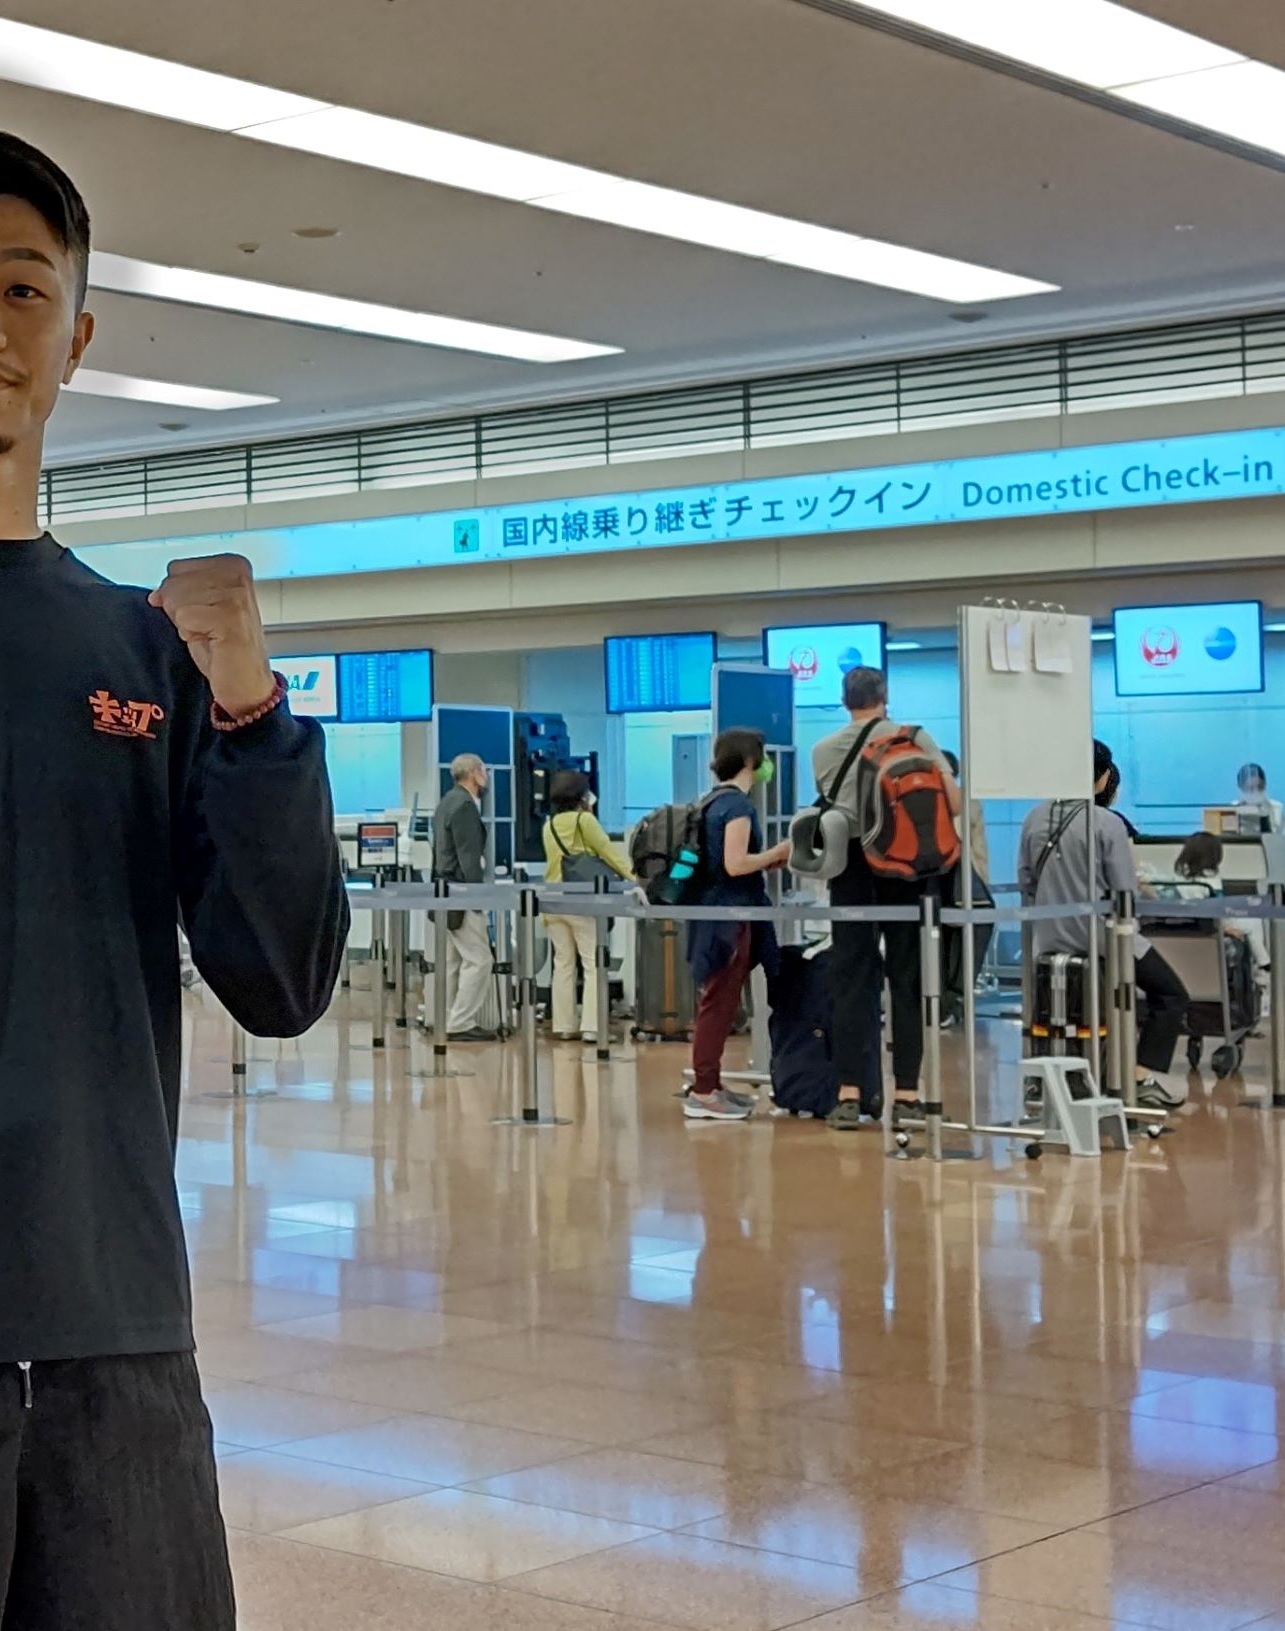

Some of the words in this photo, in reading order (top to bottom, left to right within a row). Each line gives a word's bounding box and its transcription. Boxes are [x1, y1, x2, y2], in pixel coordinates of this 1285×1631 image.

[502, 481, 932, 547] 国内線乗り継ぎチェックイン
[962, 470, 1109, 507] Domestic
[1121, 454, 1274, 493] Check-in
